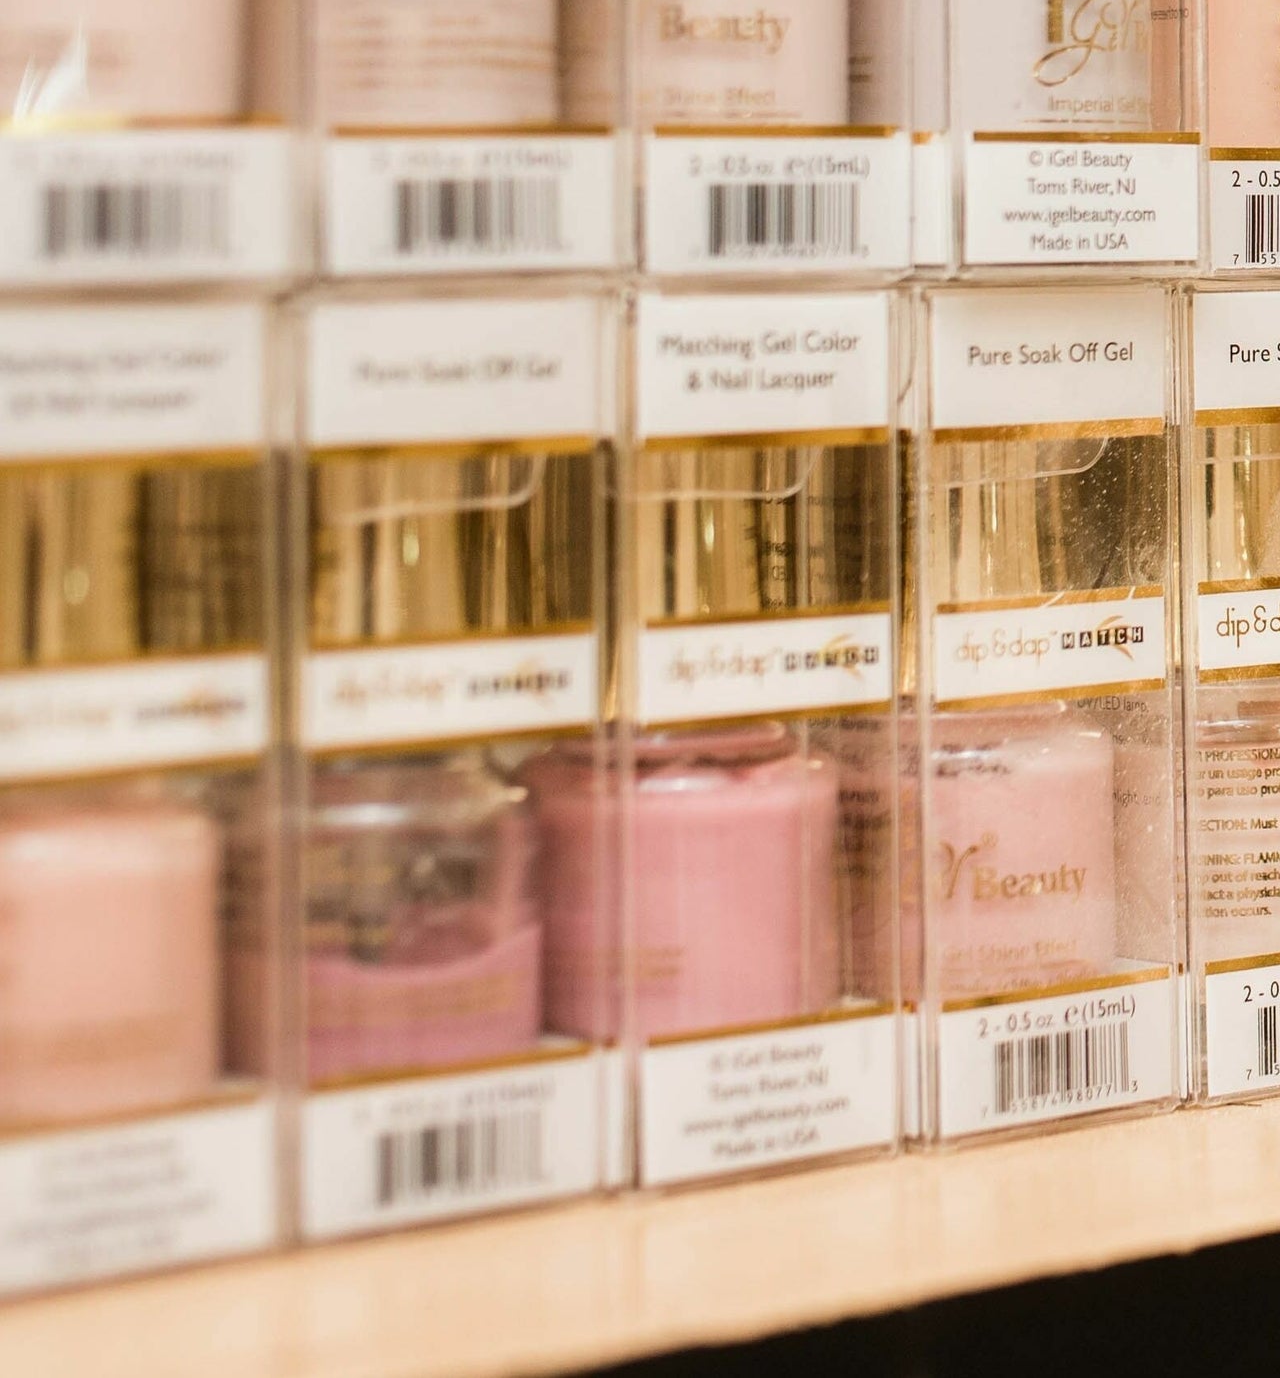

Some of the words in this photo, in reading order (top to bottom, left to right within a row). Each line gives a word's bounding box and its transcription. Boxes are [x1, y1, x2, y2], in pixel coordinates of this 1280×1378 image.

[1082, 150, 1132, 171] Beauty
[1027, 178, 1067, 195] Toms
[1072, 178, 1114, 197] River,
[1116, 178, 1136, 196] NJ
[1232, 170, 1241, 187] 2
[1259, 170, 1280, 187] 0.5
[1003, 206, 1156, 228] www.igelbeauty.com
[1030, 233, 1073, 251] Made
[1078, 234, 1090, 250] in
[1095, 233, 1129, 251] USA
[1233, 254, 1239, 265] 7
[804, 329, 860, 353] Color
[968, 344, 1012, 367] Pure
[1018, 343, 1062, 365] Soak
[1069, 342, 1098, 363] Off
[1104, 341, 1133, 362] Gel
[1229, 344, 1270, 363] Pure
[1061, 625, 1144, 650] MATCH
[1207, 786, 1234, 800] para
[1250, 816, 1279, 830] Must
[972, 862, 1087, 906] Beauty
[1212, 871, 1232, 884] out
[1250, 867, 1280, 882] reach
[1243, 985, 1253, 1003] 2
[979, 1018, 989, 1038] 2
[1246, 1069, 1252, 1081] 7
[1067, 1084, 1112, 1103] 98077
[1131, 1080, 1138, 1094] 3
